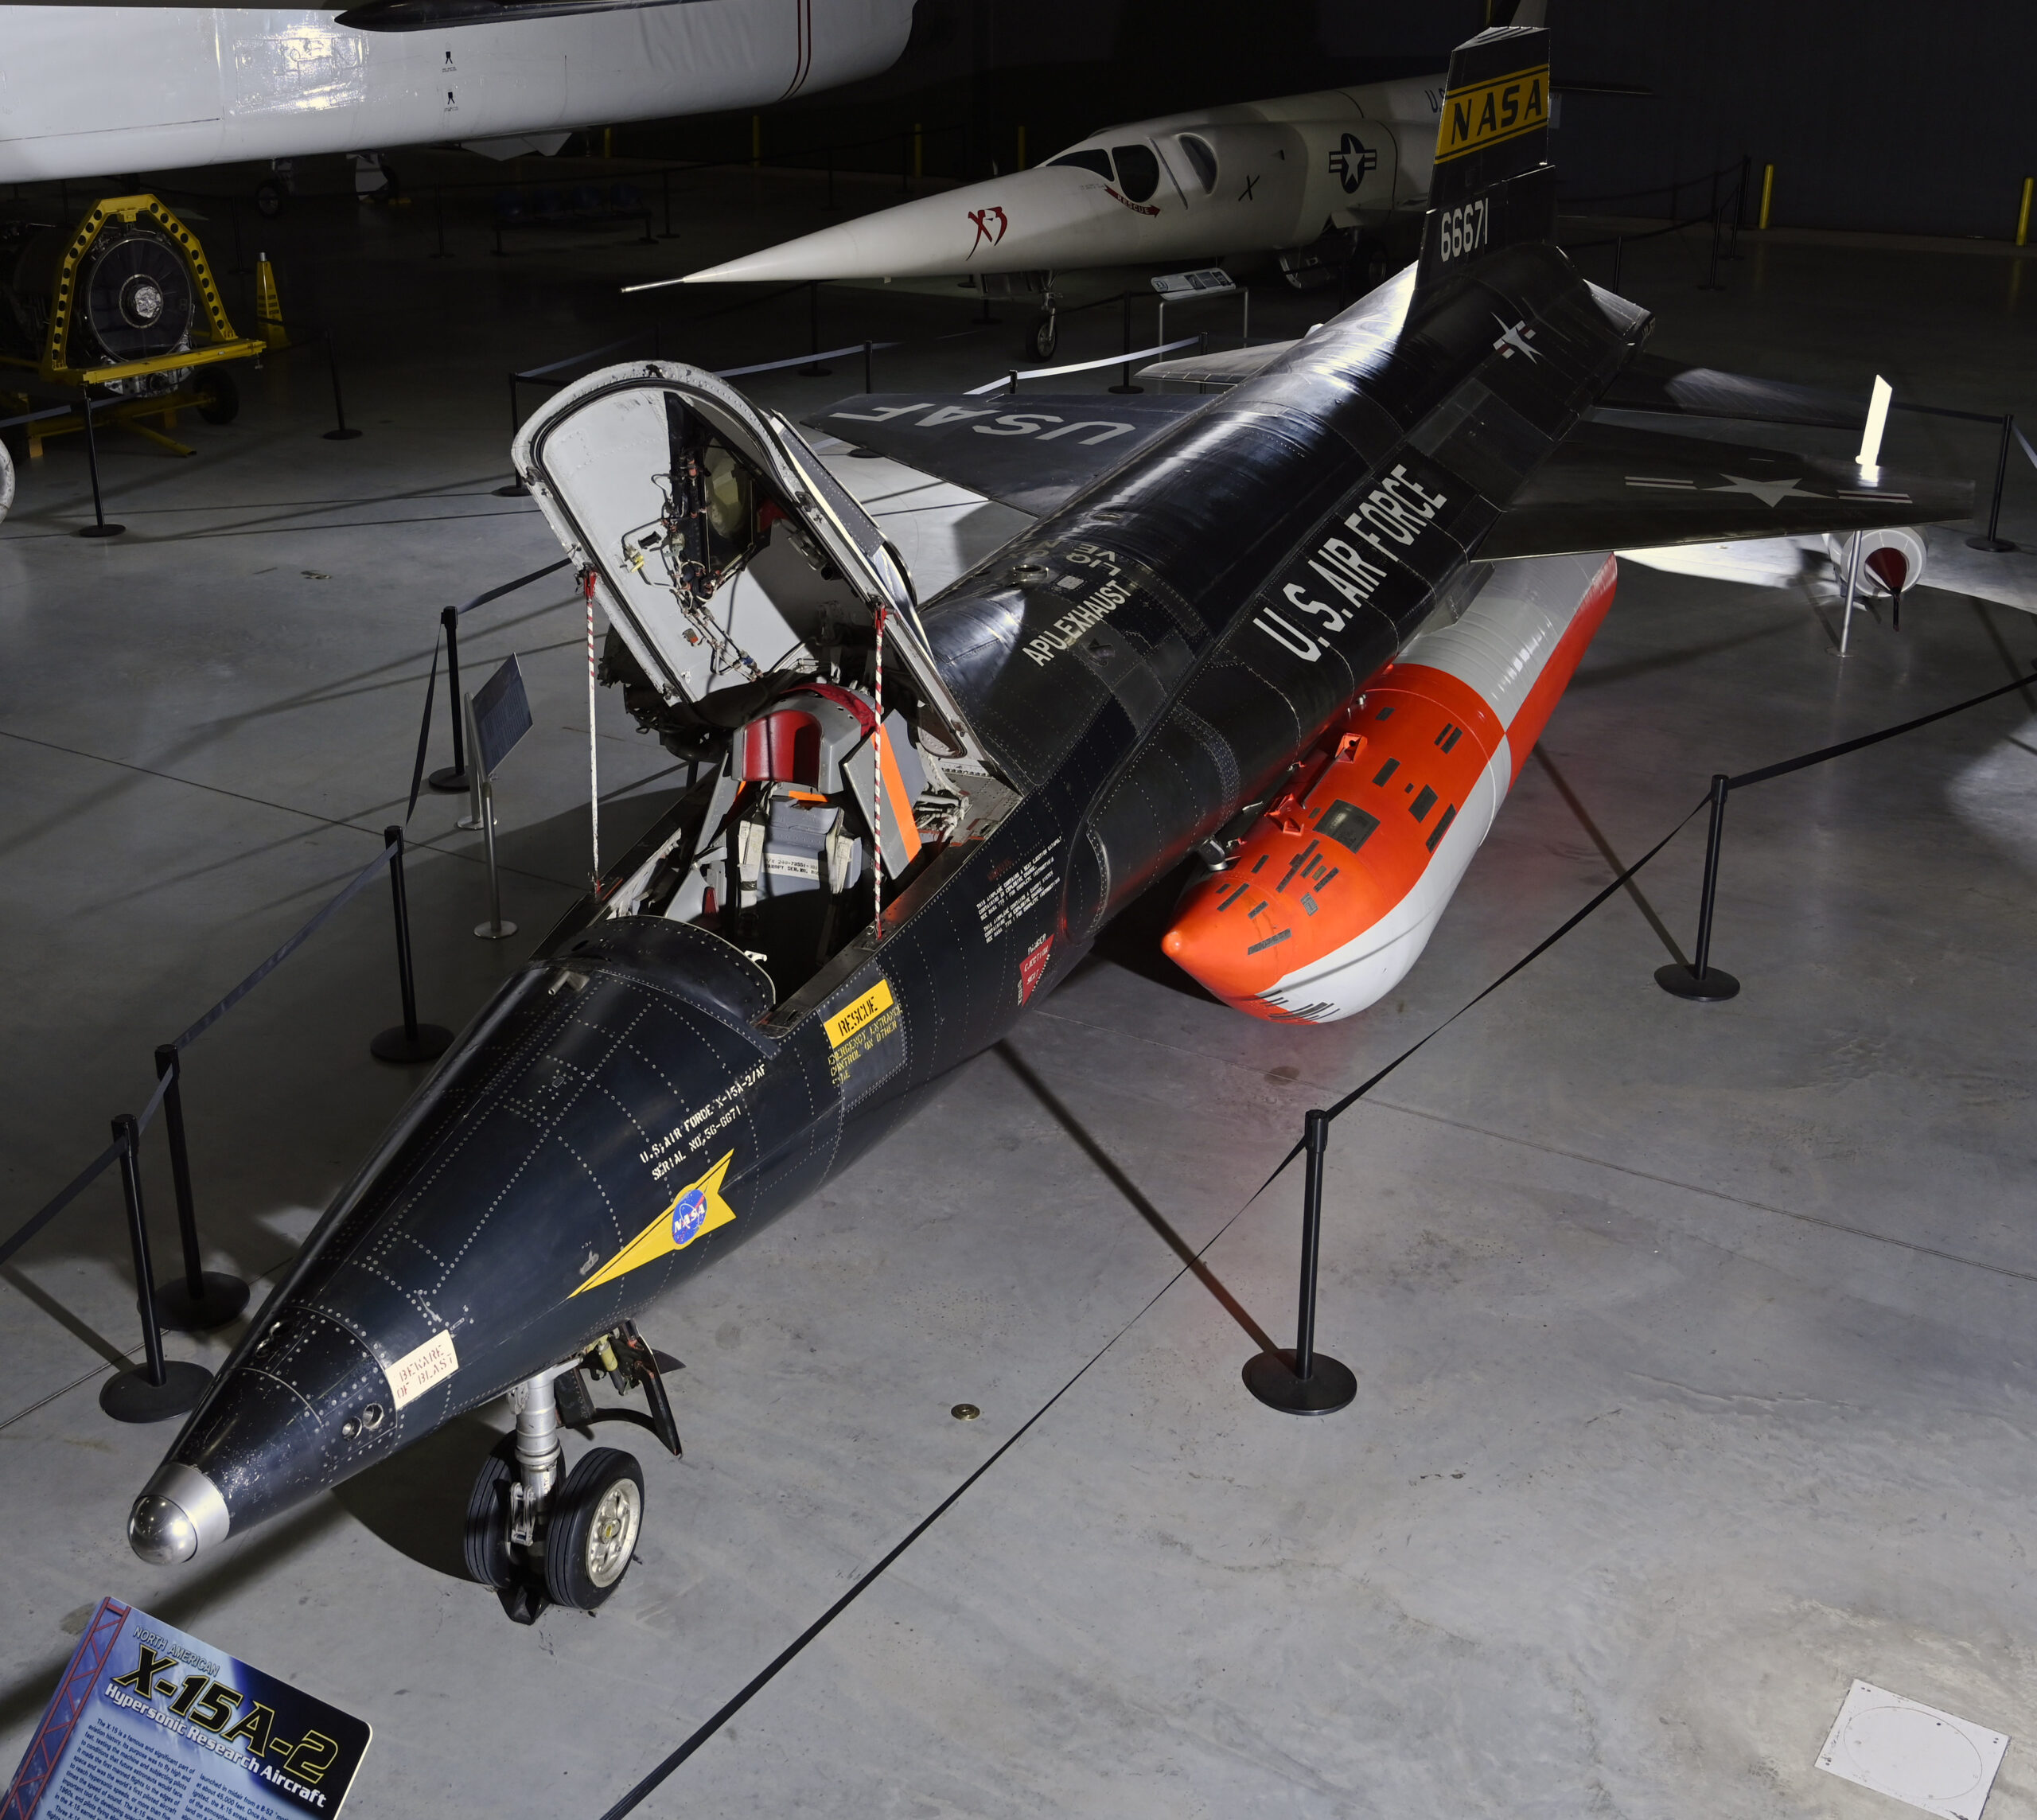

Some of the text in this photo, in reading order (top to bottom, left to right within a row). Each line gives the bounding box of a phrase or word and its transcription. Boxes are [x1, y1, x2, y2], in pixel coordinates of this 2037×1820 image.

[1451, 79, 1542, 145] NASA
[1441, 197, 1488, 261] 66671
[828, 403, 1135, 446] USAF
[1345, 464, 1448, 563] FORCE
[1022, 579, 1131, 667] APU EXHAUST
[838, 996, 878, 1037] RESCUE
[830, 1020, 898, 1078] CONTROL ON OTHER
[684, 1101, 714, 1133] FORCE
[652, 1152, 687, 1181] SERIAL
[673, 1203, 706, 1233] NASA
[397, 1353, 452, 1398] OF BLAST
[400, 1345, 444, 1381] BEWARE
[133, 1626, 220, 1677] NORTH AMERICAN
[111, 1643, 338, 1784] X-15A-2
[86, 1743, 108, 1758] conditions
[119, 1760, 133, 1771] future
[133, 1768, 157, 1783] astronauts
[158, 1782, 172, 1791] would
[88, 1725, 105, 1736] aviation
[128, 1747, 146, 1759] purpose
[170, 1767, 181, 1777] high
[95, 1737, 111, 1751] testing
[119, 1752, 138, 1764] machine
[149, 1767, 173, 1783] subjecting
[173, 1780, 186, 1790] pilots
[104, 1682, 327, 1808] Hypersonic Research Aircraft
[106, 1723, 118, 1733] X-15
[127, 1734, 144, 1748] famous
[154, 1750, 177, 1765] significant
[177, 1763, 189, 1771] part
[62, 1777, 83, 1793] important
[100, 1799, 123, 1816] developing
[66, 1770, 78, 1780] times
[87, 1783, 101, 1793] speed
[123, 1801, 132, 1810] The
[133, 1806, 146, 1817] X-15
[73, 1756, 87, 1765] space
[115, 1779, 131, 1790] world's
[132, 1787, 142, 1796] first
[142, 1793, 159, 1805] piloted
[159, 1802, 176, 1814] aircraft
[75, 1766, 88, 1775] reach
[88, 1772, 112, 1789] hypersonic
[137, 1800, 149, 1810] more
[150, 1806, 161, 1816] than
[81, 1750, 94, 1759] made
[102, 1760, 111, 1769] first
[111, 1767, 130, 1779] manned
[130, 1775, 144, 1787] flights
[159, 1792, 173, 1802] edges
[200, 1773, 221, 1788] launched
[228, 1789, 243, 1799] midair
[243, 1796, 255, 1806] from
[260, 1805, 273, 1815] B-52
[55, 1805, 68, 1816] Three
[68, 1800, 80, 1810] X-15
[80, 1808, 96, 1820] earned
[83, 1800, 95, 1810] pilots
[96, 1806, 109, 1818] flying
[185, 1805, 196, 1814] land
[201, 1786, 216, 1795] about
[216, 1792, 234, 1805] 45,000
[247, 1808, 259, 1819] Once
[219, 1803, 232, 1814] X-15
